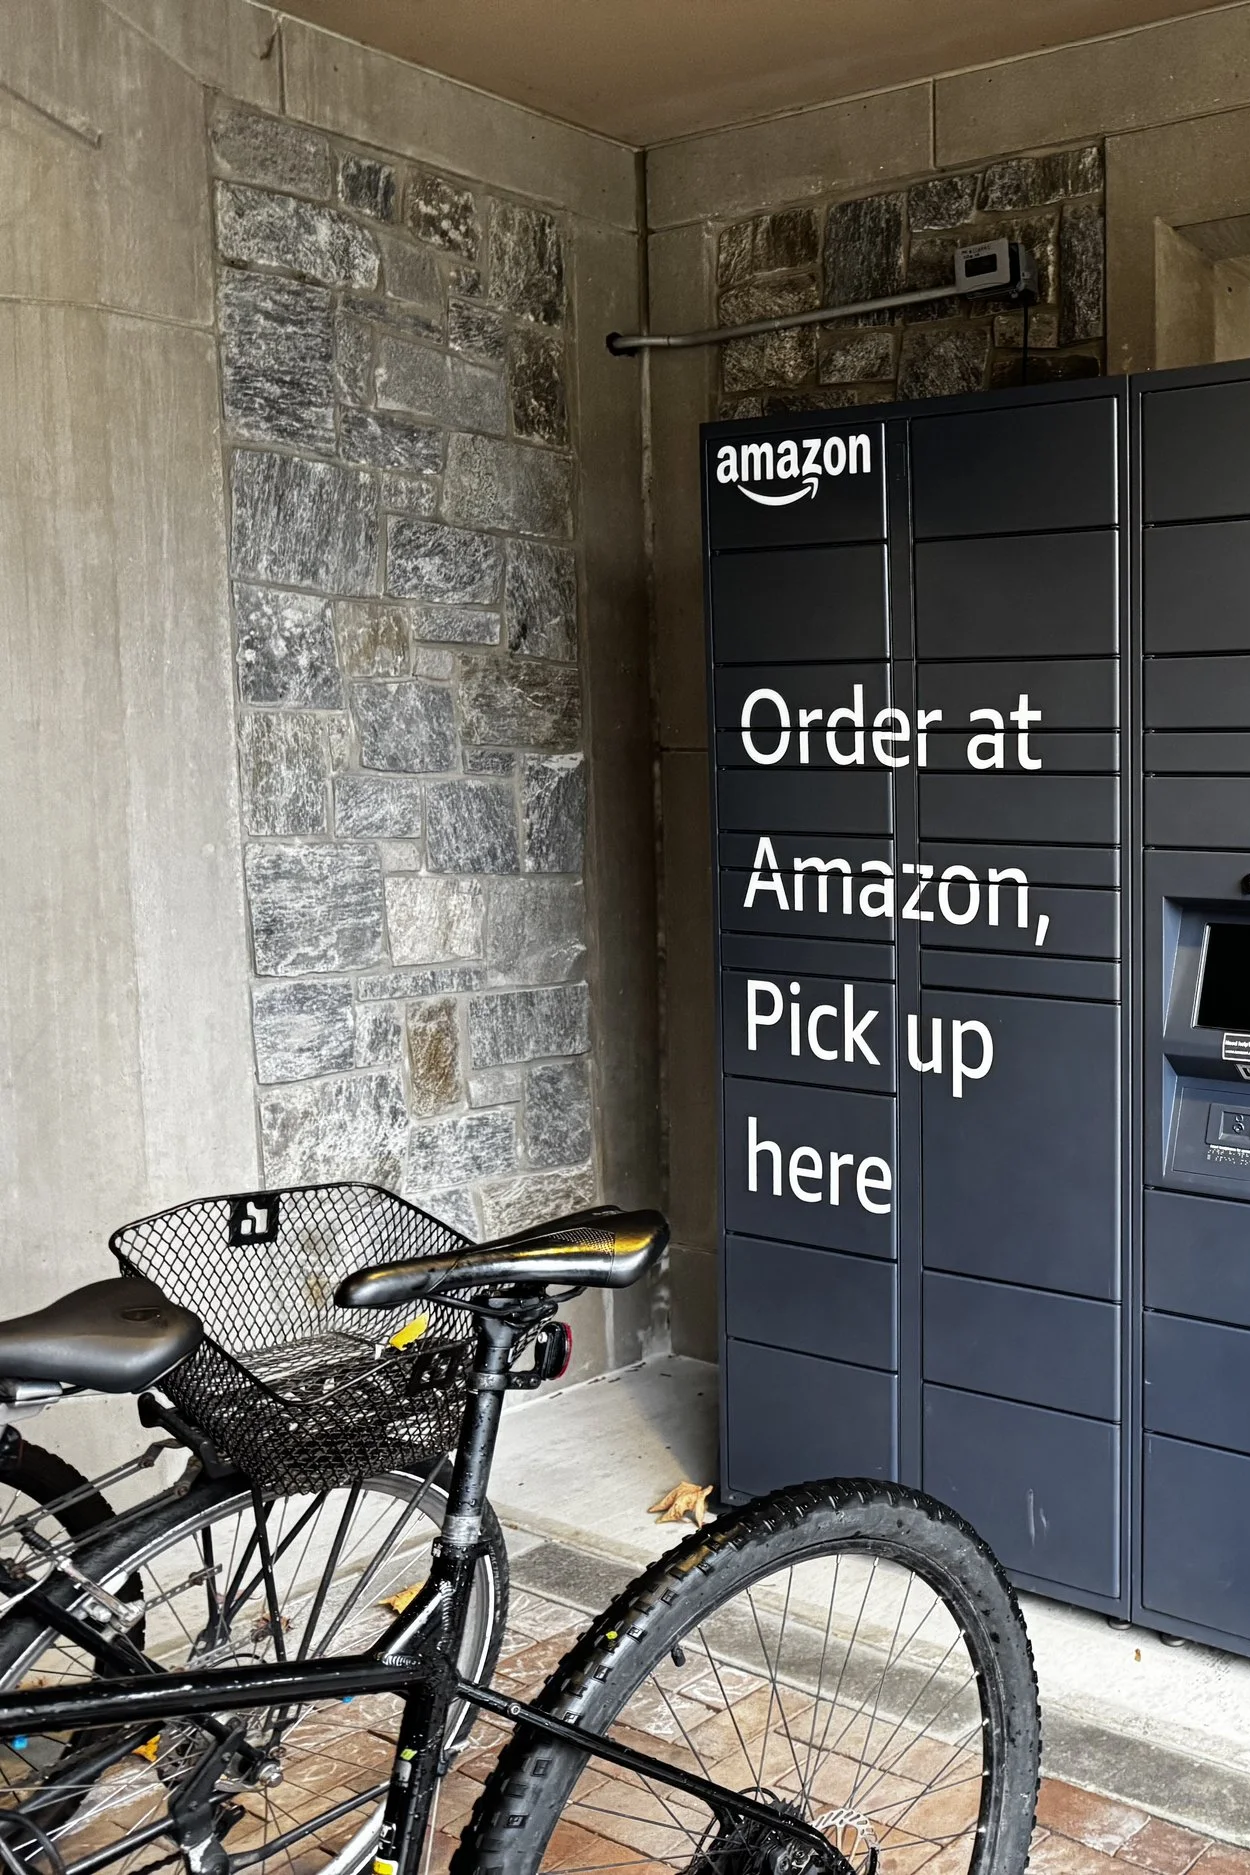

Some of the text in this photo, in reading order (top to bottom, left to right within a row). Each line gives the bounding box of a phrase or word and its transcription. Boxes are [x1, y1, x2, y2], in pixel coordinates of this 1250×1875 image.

[716, 433, 872, 484] amazon
[740, 683, 1043, 770] Order at
[742, 835, 1051, 947] Amazon,
[746, 978, 995, 1099] Pick up
[747, 1115, 893, 1215] here
